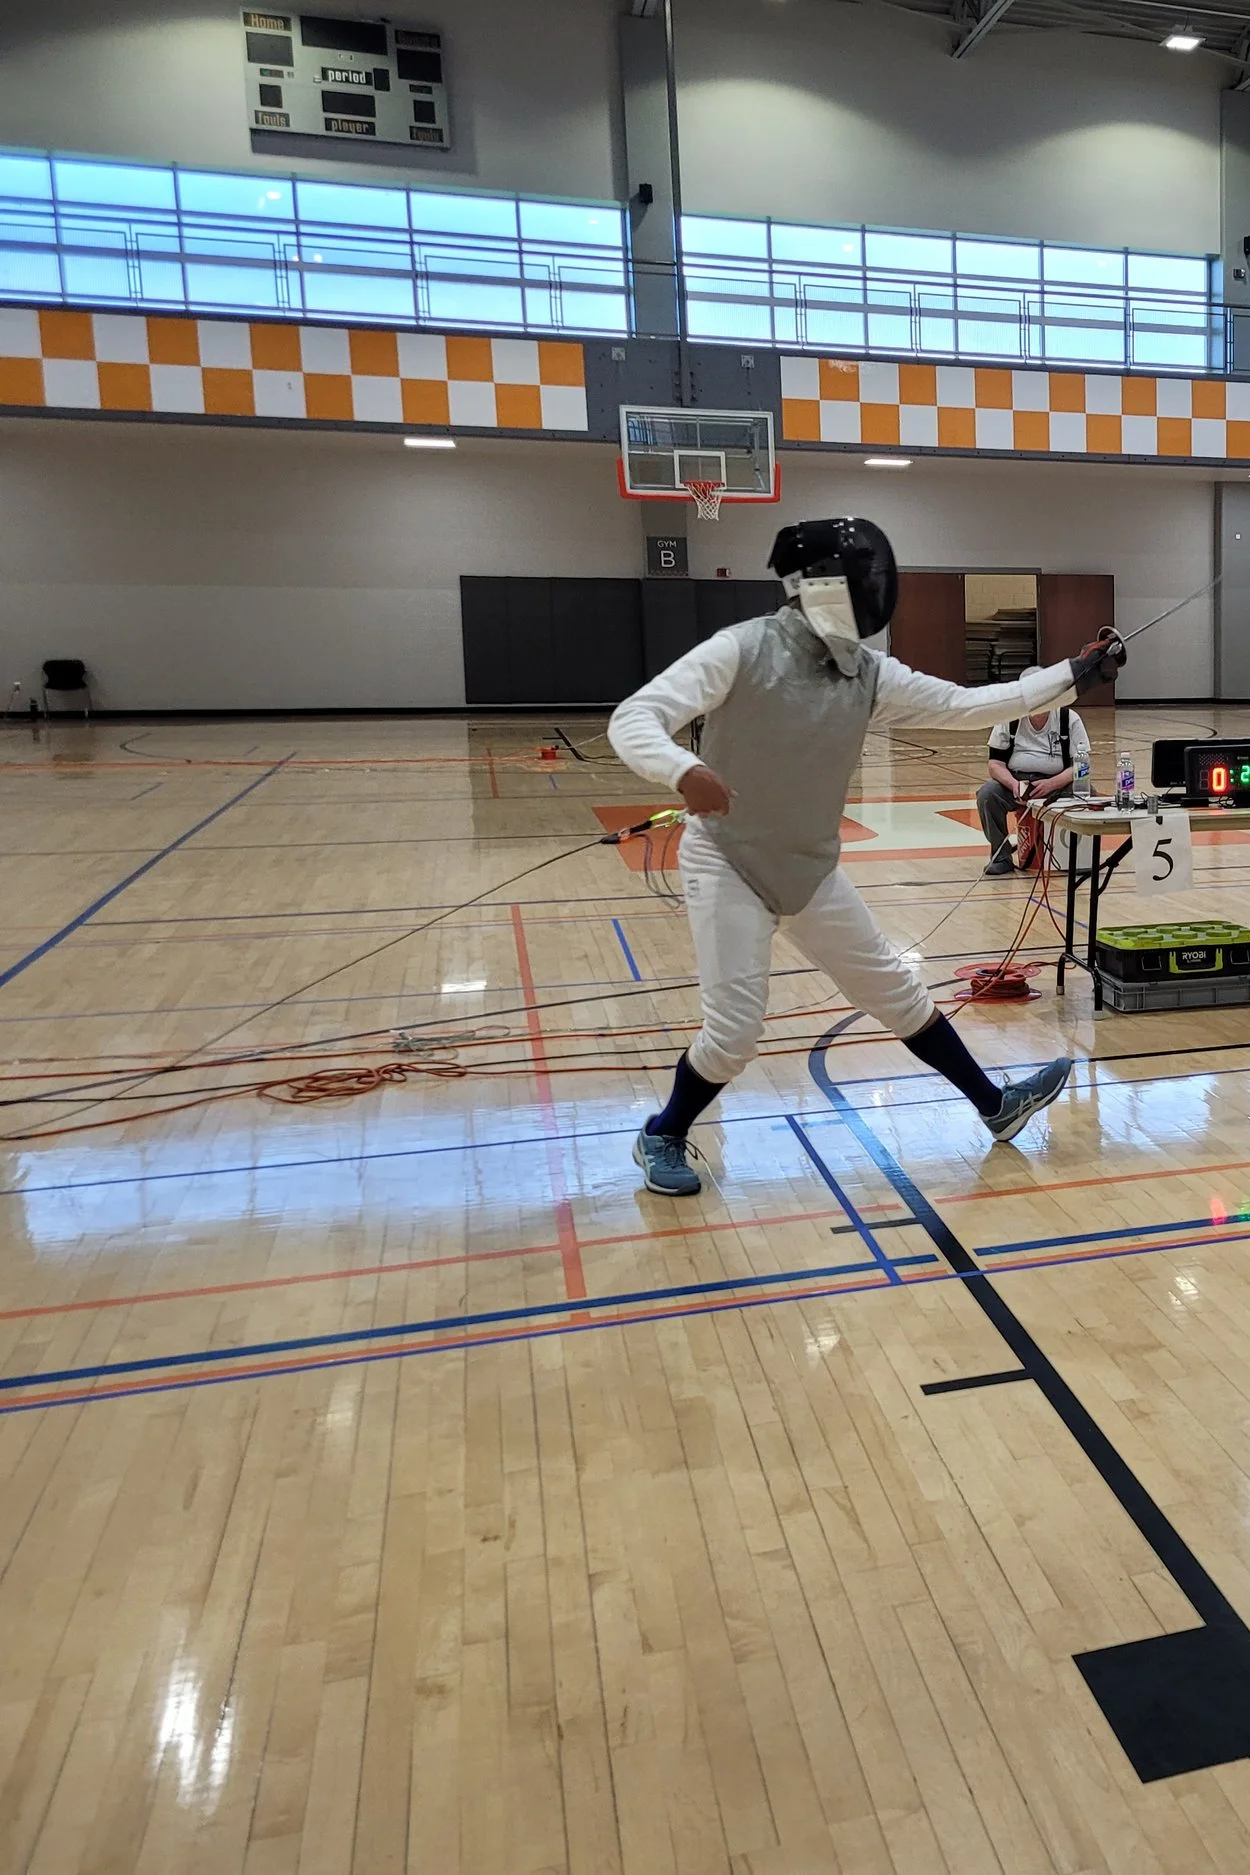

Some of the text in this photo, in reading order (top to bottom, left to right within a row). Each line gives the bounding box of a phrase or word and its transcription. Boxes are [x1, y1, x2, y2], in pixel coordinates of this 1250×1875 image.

[251, 14, 285, 30] Home
[328, 69, 366, 84] period
[331, 119, 369, 135] player
[657, 540, 677, 548] GYM
[660, 550, 676, 568] B
[1212, 767, 1226, 791] 0
[1152, 838, 1174, 881] 5
[1182, 951, 1206, 960] RYOBI
